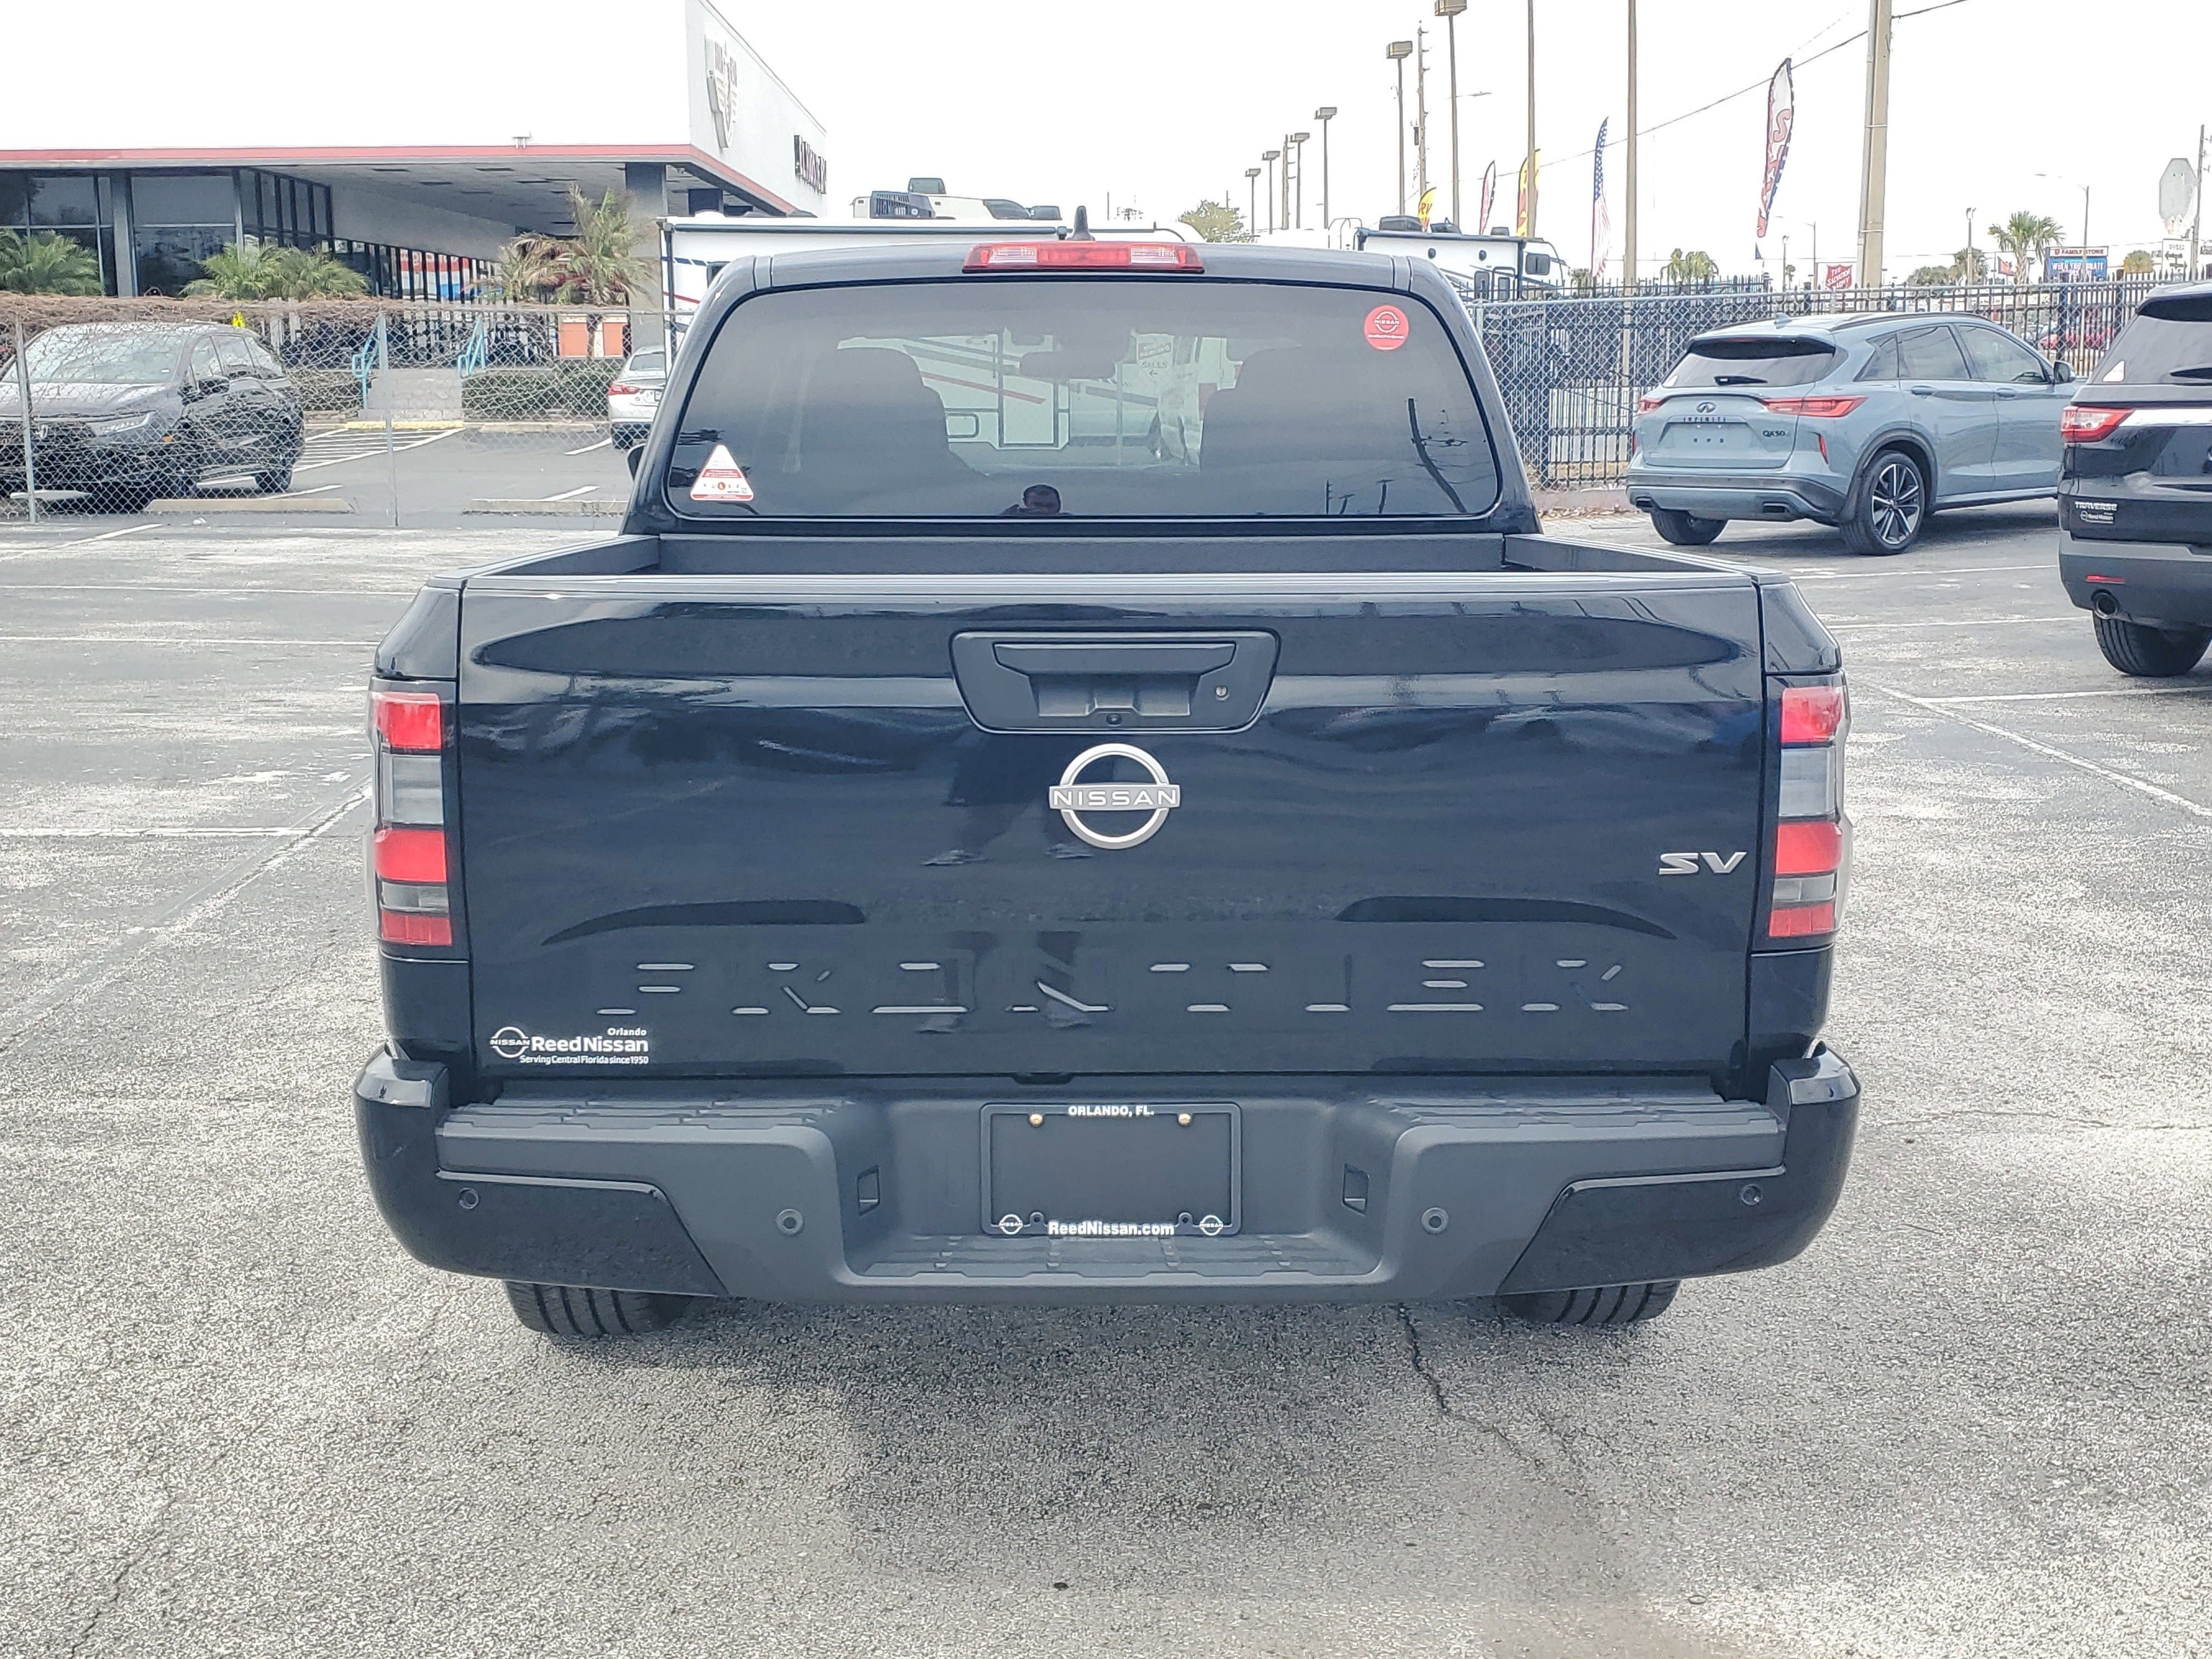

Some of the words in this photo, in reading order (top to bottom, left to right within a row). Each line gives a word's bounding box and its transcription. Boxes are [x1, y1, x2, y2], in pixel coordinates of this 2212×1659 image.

[1762, 430, 1786, 438] QX50
[2074, 501, 2118, 511] TRAVERSE
[1053, 789, 1177, 806] NISSAN
[1658, 851, 1747, 875] SV
[607, 1027, 647, 1036] Orlando
[1068, 1105, 1133, 1118] ORLANDO,
[1135, 1105, 1155, 1116] FL.
[1048, 1221, 1176, 1237] ReedNissan.com
